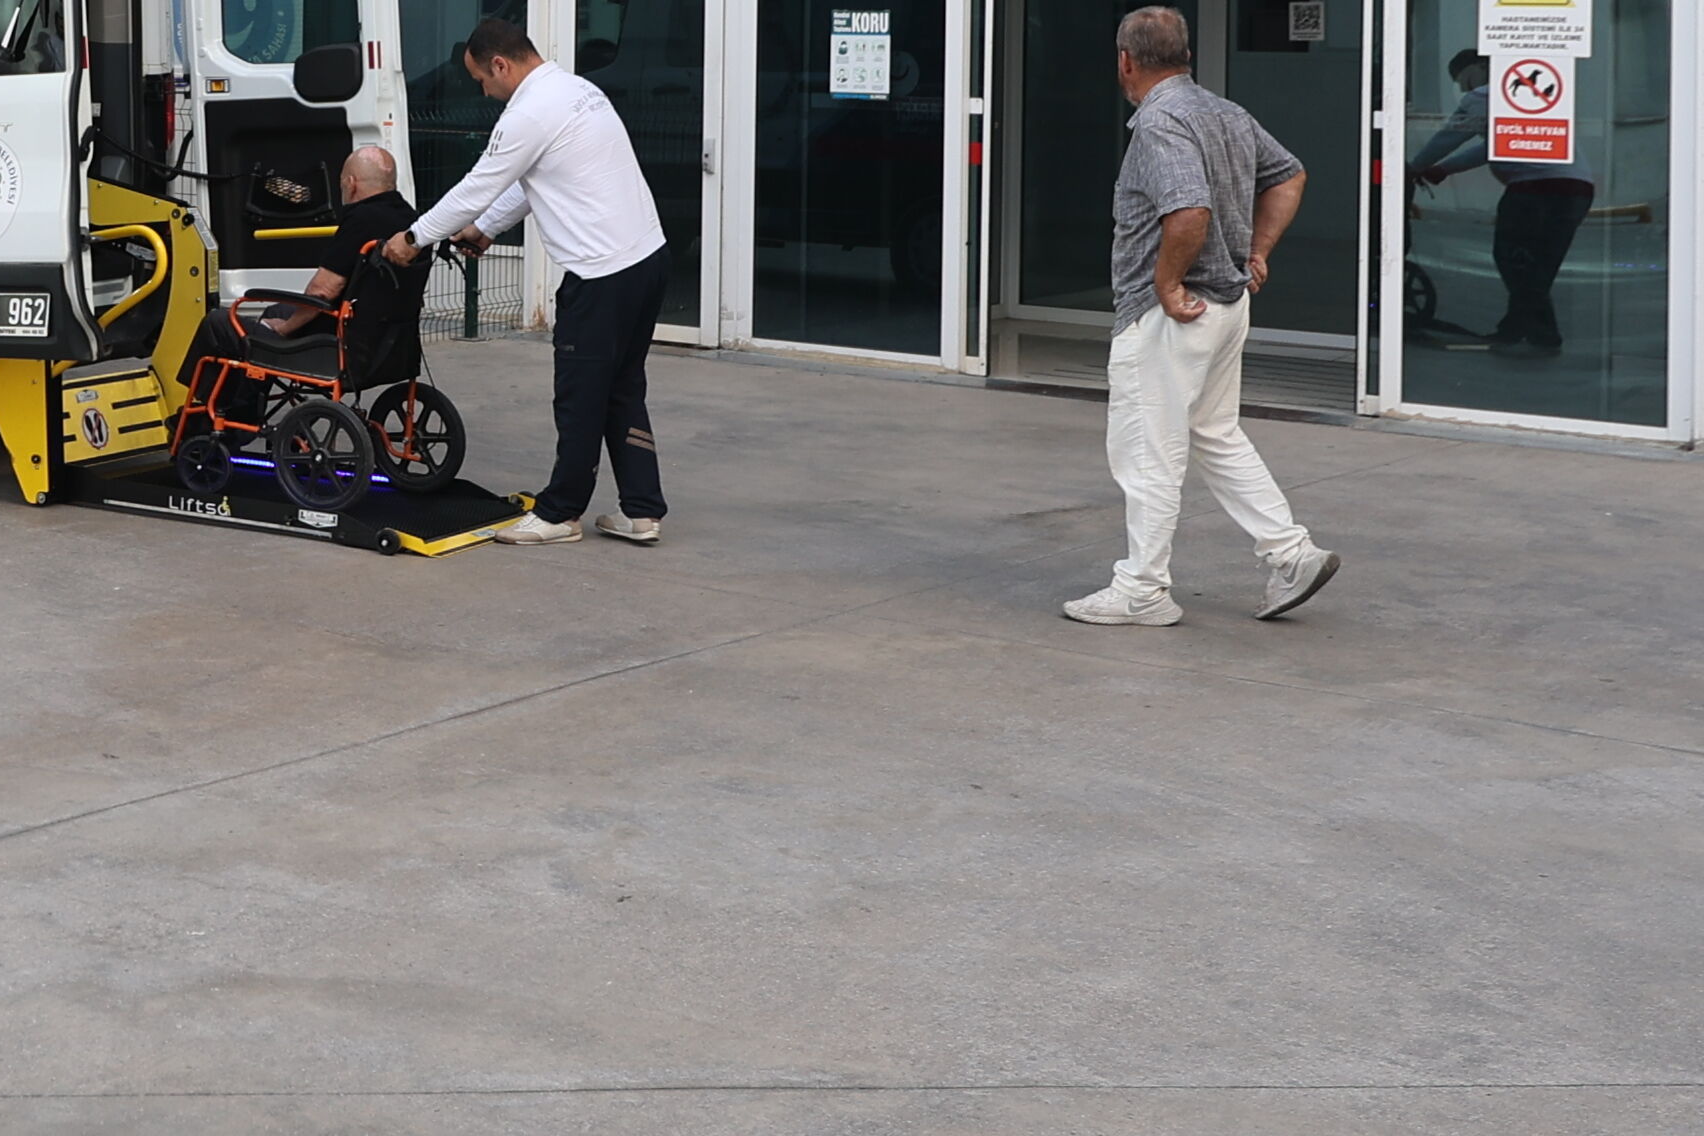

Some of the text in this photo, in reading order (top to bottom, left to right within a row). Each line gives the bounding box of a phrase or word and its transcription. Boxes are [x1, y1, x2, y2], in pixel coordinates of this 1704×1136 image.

[852, 12, 889, 33] KORU
[1496, 123, 1567, 136] EVCİL HAYVAN
[1508, 139, 1553, 151] GİREMEZ
[8, 297, 46, 325] 962
